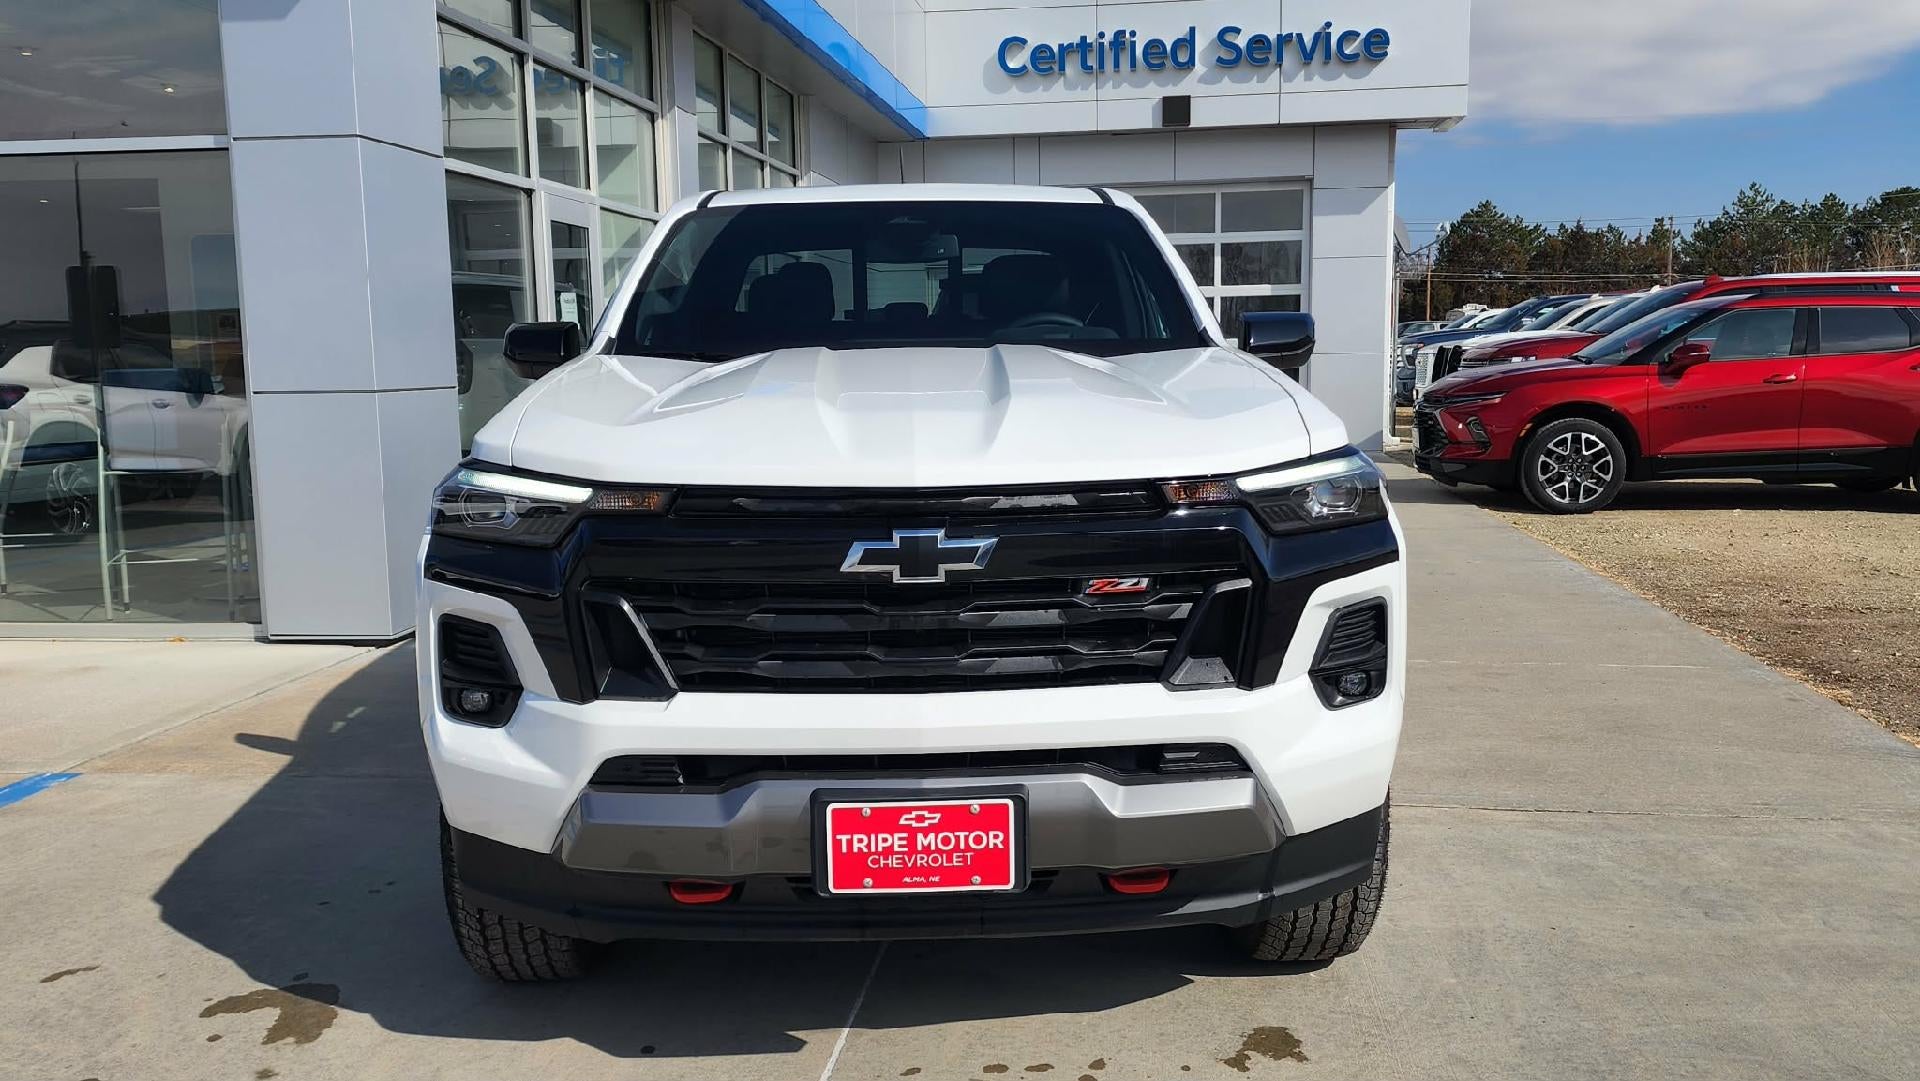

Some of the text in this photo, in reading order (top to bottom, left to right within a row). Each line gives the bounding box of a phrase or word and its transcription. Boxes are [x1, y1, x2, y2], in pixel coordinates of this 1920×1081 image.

[997, 21, 1390, 76] Certified Service
[836, 830, 1004, 853] TRIPE MOTOR
[867, 852, 974, 868] CHEVROLET
